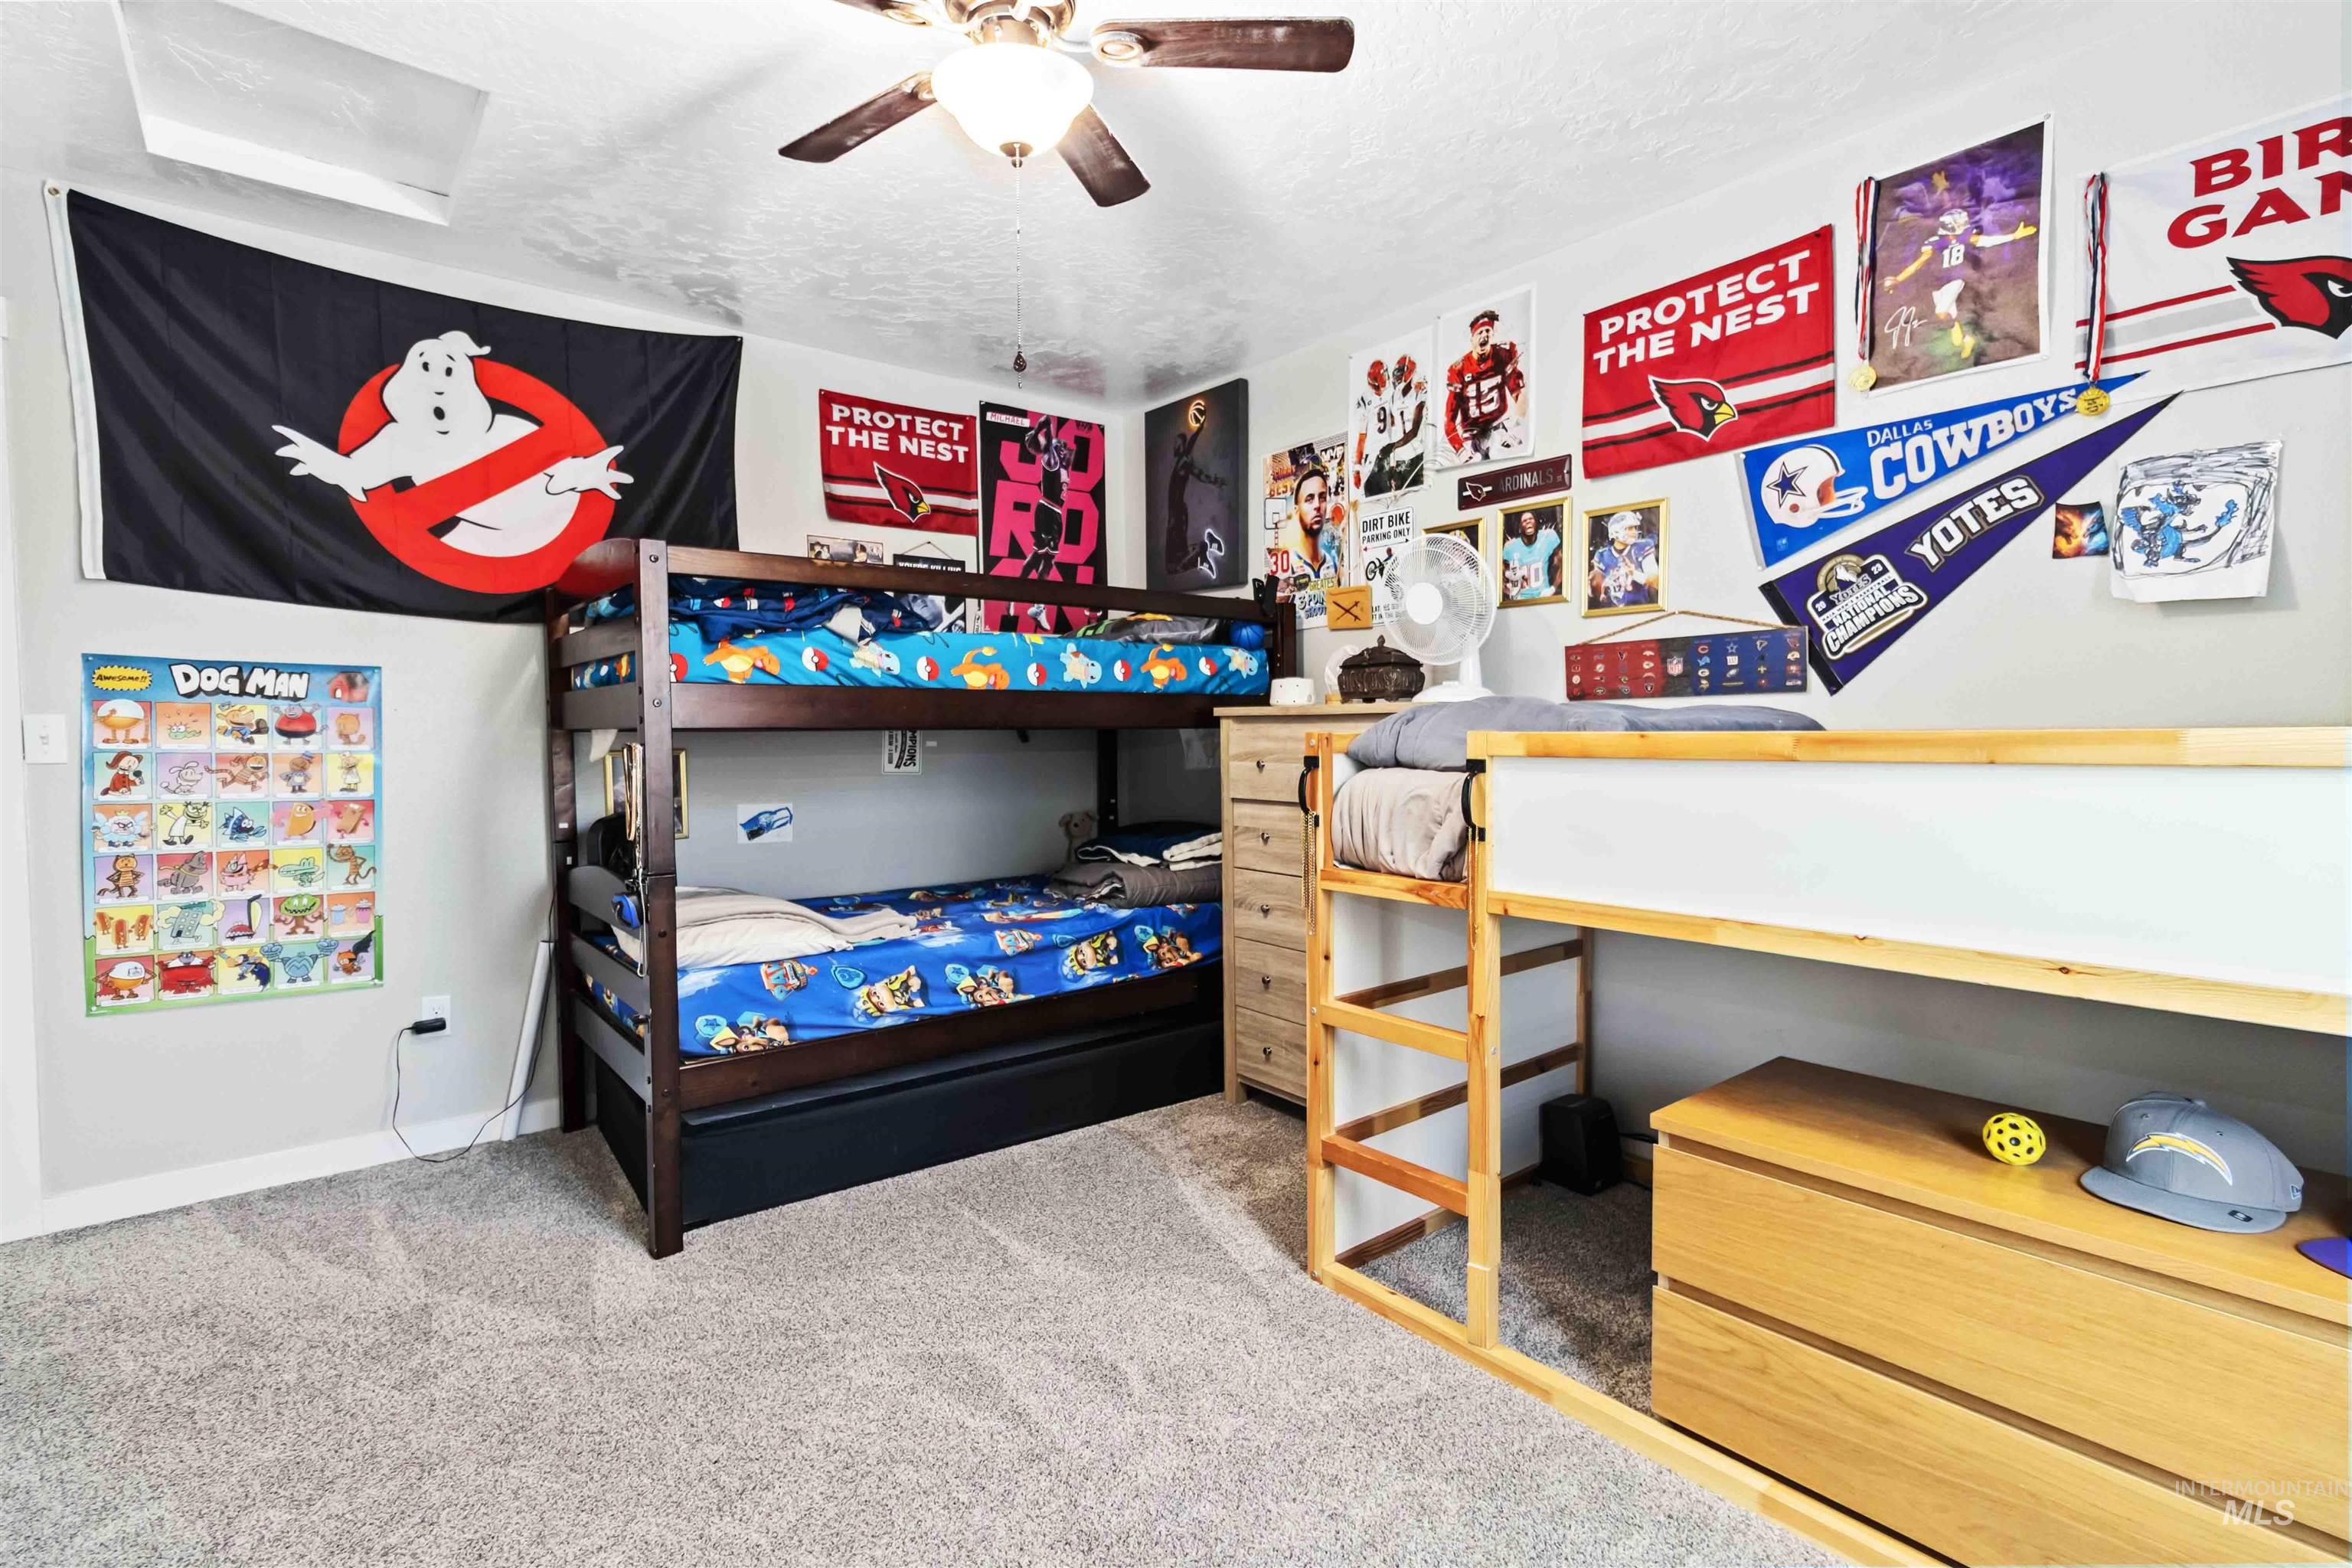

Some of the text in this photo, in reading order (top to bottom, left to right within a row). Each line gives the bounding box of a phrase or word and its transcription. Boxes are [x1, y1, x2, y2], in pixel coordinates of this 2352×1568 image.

[1942, 244, 1965, 269] 18
[1599, 250, 1810, 344] PROTECT
[1593, 282, 1819, 374] THE NEST
[1464, 374, 1503, 419] 15
[831, 403, 964, 441] PROTECT
[990, 413, 1026, 426] MICHAEL
[1377, 406, 1387, 434] 9
[825, 425, 969, 463] THE NEST
[1866, 420, 1934, 448] DALLAS
[1870, 388, 2078, 500] COWBOYS
[1320, 445, 1344, 460] MVP
[1498, 468, 1554, 494] ARDINALS
[1362, 511, 1410, 533] DIRT BIKE
[1362, 528, 1410, 544] PARKING ONLY
[1909, 476, 2043, 570] YOTES
[1269, 550, 1290, 576] 30
[1871, 563, 1883, 575] 23
[1308, 591, 1326, 606] POIN
[1310, 578, 1336, 592] GREATES
[1830, 574, 1872, 603] YOTES
[1305, 606, 1327, 619] SHOOT
[1815, 600, 1827, 612] 20
[1826, 586, 1919, 653] CHAMPIONS
[1831, 586, 1891, 626] NATIONAL
[170, 663, 309, 699] DOG MAN
[903, 730, 917, 767] MPIONS
